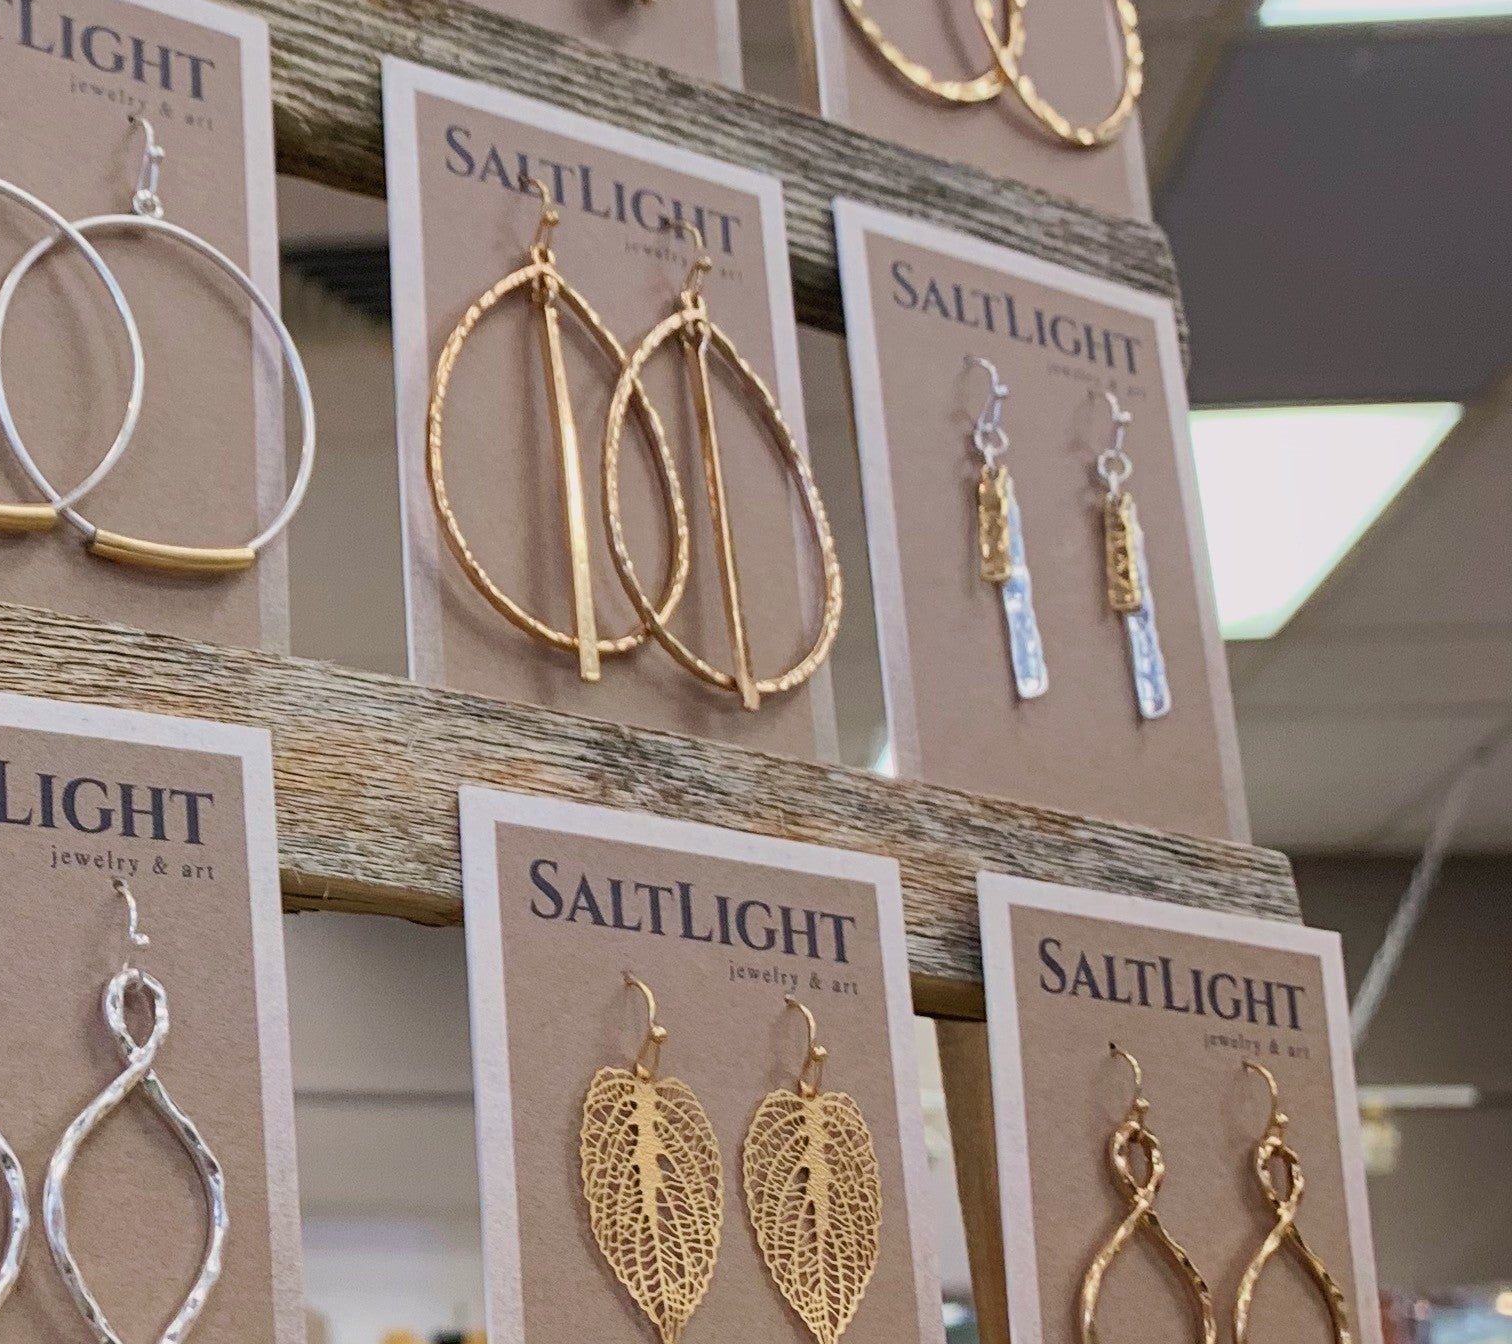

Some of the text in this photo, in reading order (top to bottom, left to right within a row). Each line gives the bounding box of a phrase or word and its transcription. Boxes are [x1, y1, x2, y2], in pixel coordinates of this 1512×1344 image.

[50, 844, 215, 881] jewelry & art
[729, 959, 859, 996] jewelry & art
